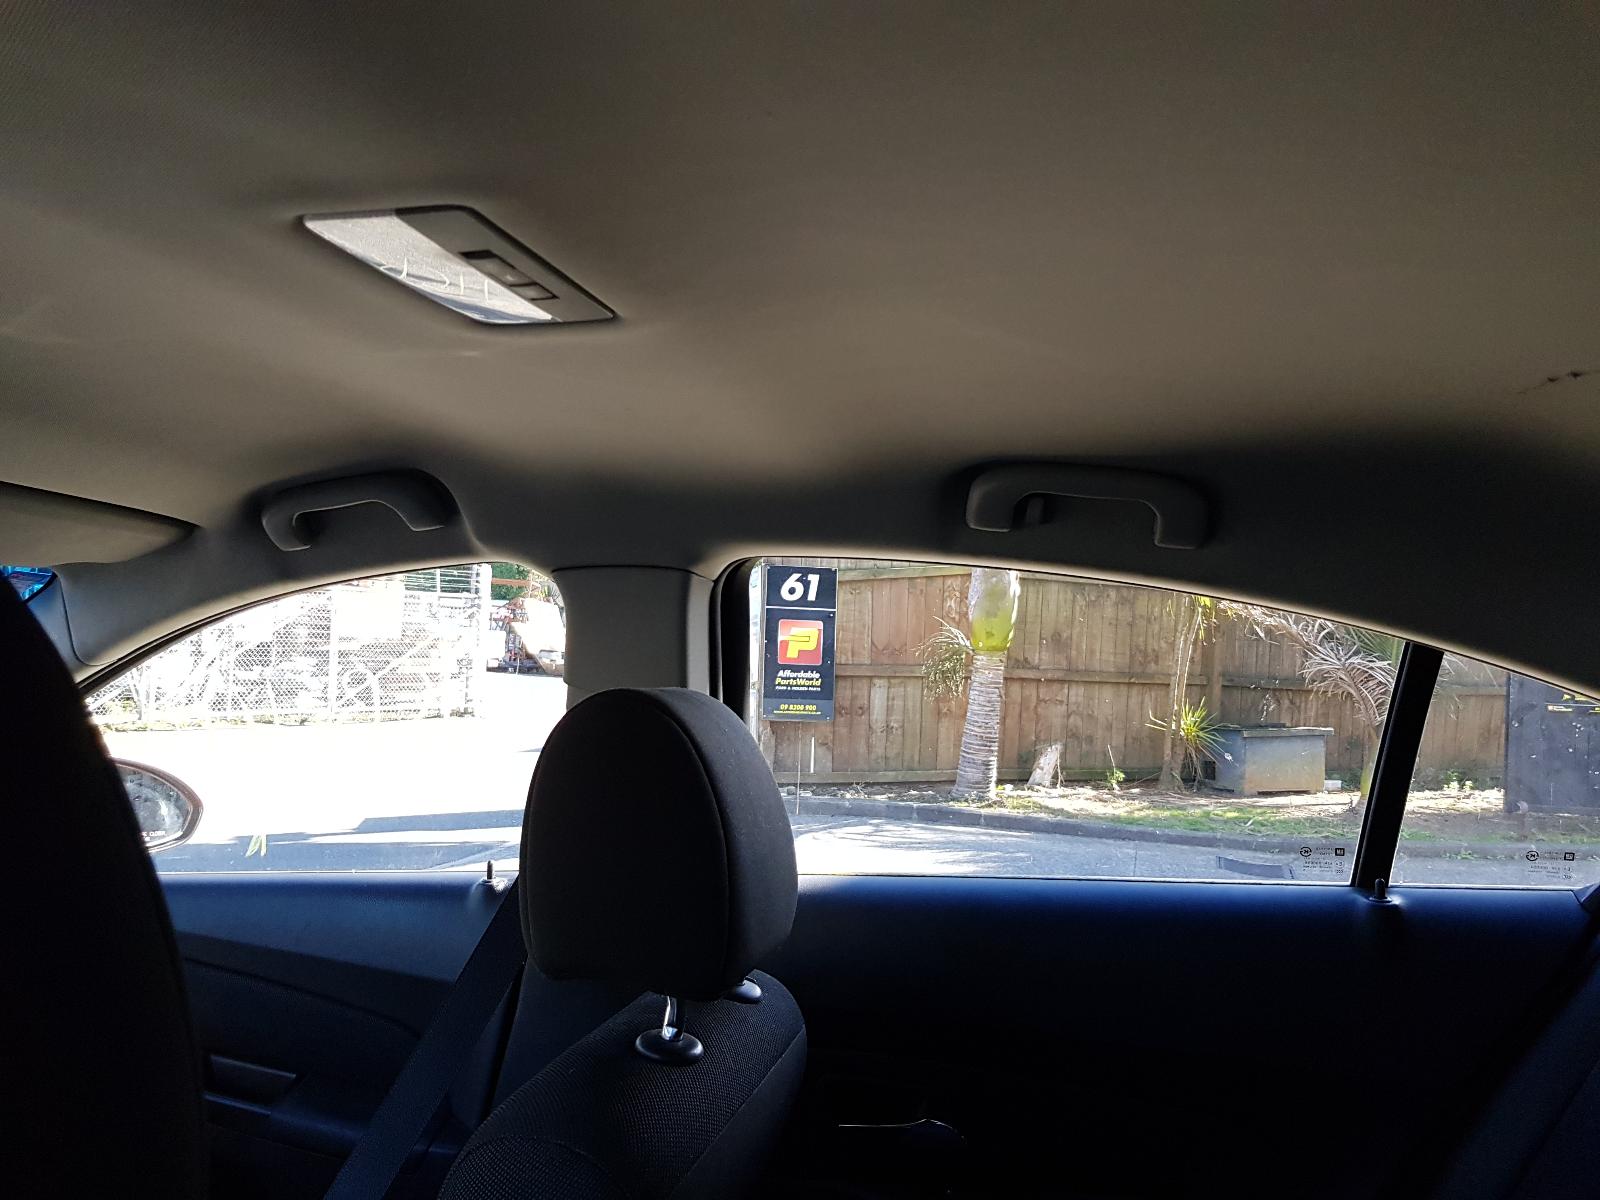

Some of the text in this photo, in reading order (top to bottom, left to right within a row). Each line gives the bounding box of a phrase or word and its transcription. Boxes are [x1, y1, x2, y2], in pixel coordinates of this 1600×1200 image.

[780, 573, 820, 602] 61
[777, 669, 821, 679] Affordable
[775, 677, 822, 687] PartsWorld
